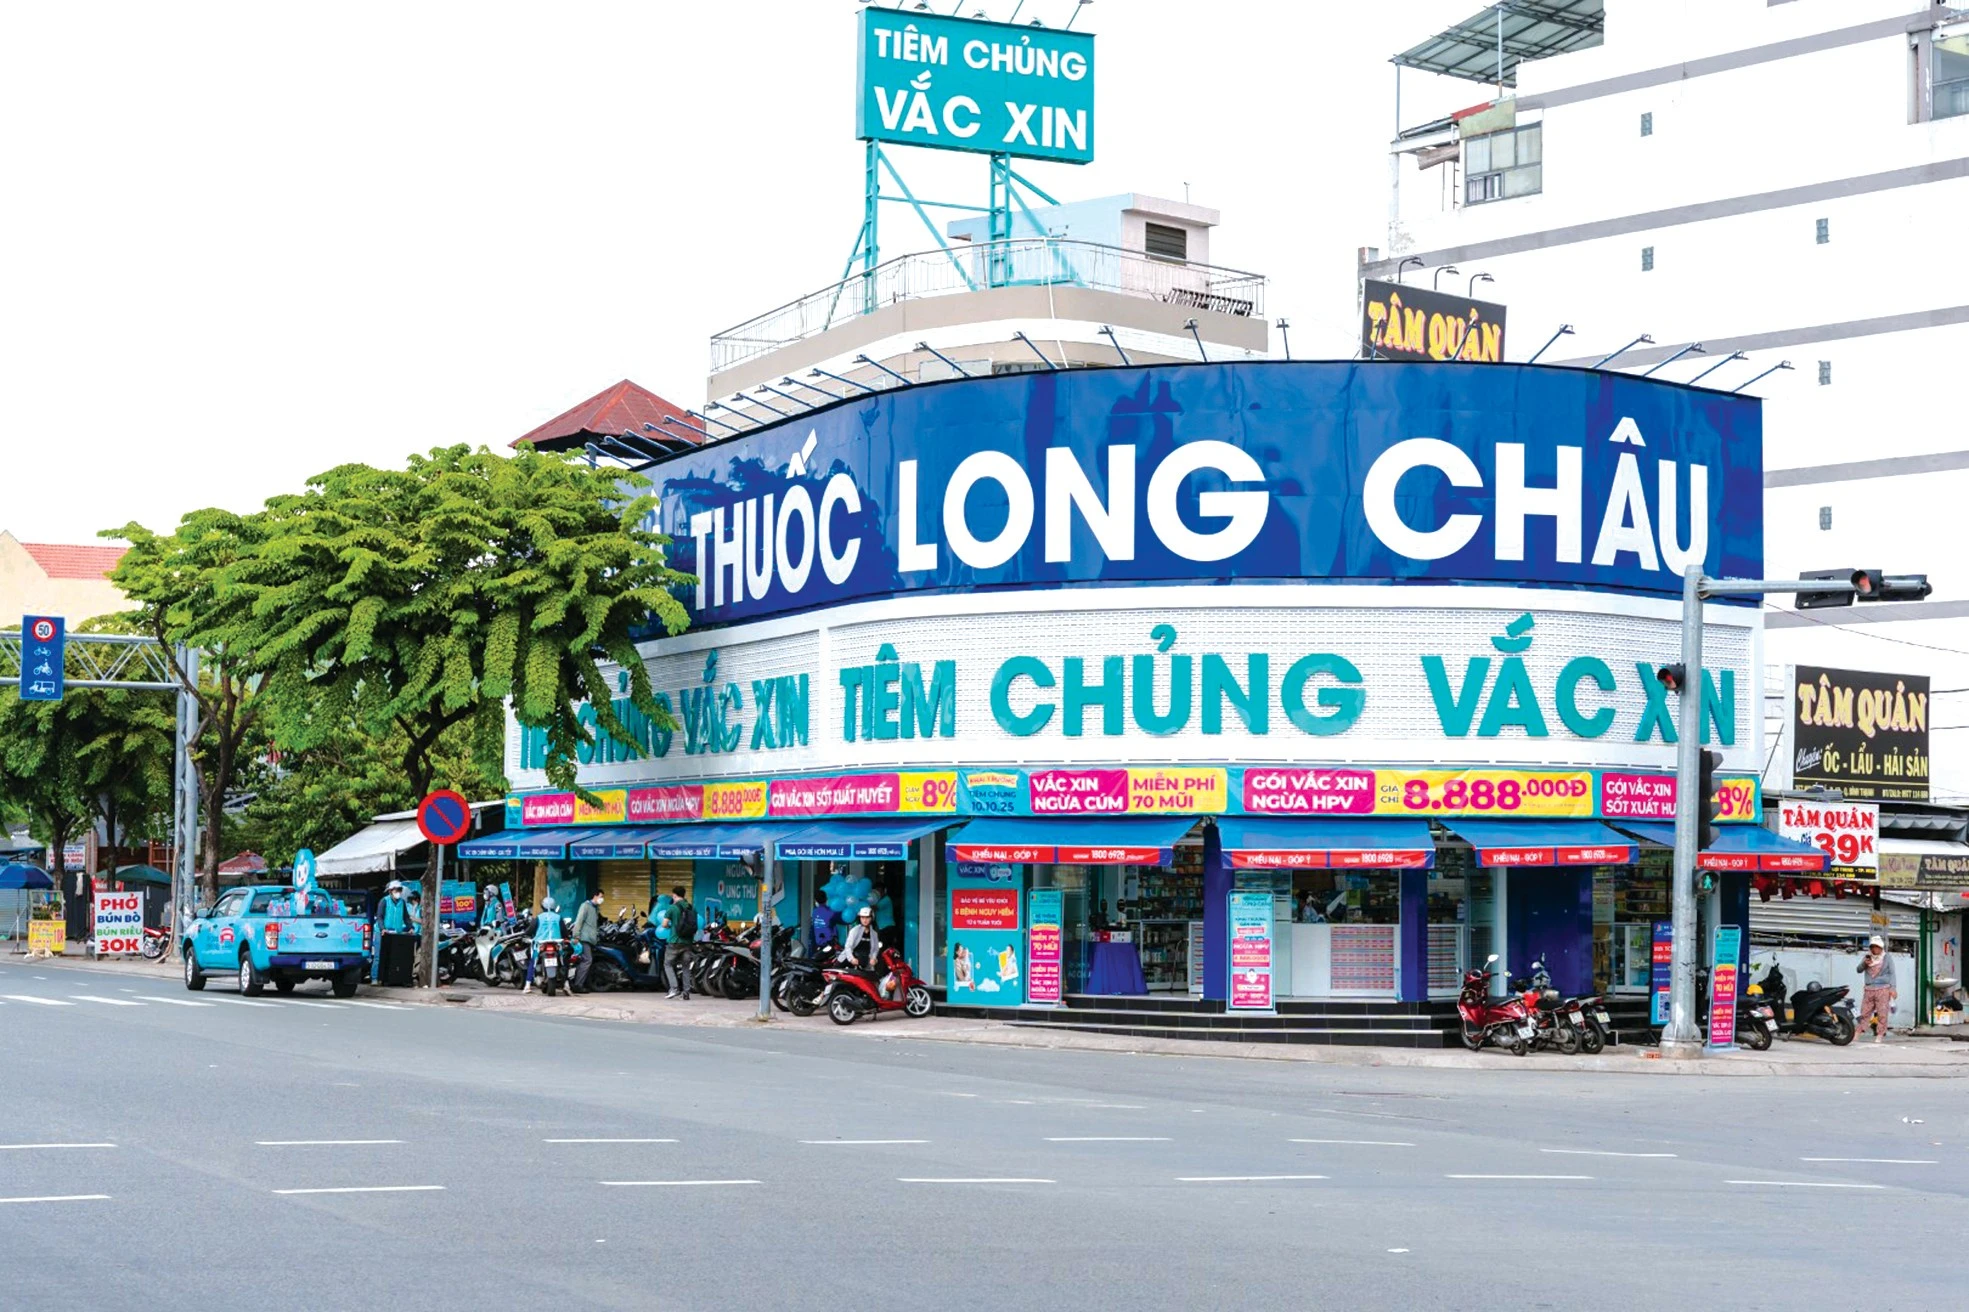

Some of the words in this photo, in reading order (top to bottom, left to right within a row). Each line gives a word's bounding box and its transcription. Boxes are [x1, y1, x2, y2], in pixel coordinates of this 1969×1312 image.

[873, 24, 948, 65] TIÊM
[963, 35, 1088, 81] CHỦNG
[873, 69, 982, 138] VẮC
[1002, 101, 1087, 151] XIN
[1368, 291, 1427, 355] TÂM
[690, 428, 862, 611] THUỐC
[898, 439, 1270, 573] LONG
[1363, 416, 1709, 578] CHÂU
[37, 624, 50, 636] 50
[839, 643, 956, 742] TIÊM
[990, 623, 1366, 737] CHỦNG
[1420, 612, 1617, 738] VẮC
[1634, 661, 1735, 746] XN
[680, 647, 743, 755] VẮC
[751, 673, 809, 751] XIN
[1798, 673, 1854, 728] TÂM
[1823, 742, 1840, 773] ỐC
[1883, 747, 1904, 776] HẢI
[1906, 747, 1928, 777] SẢN
[1032, 773, 1067, 792] VẮC
[1069, 776, 1098, 791] XIN
[1133, 772, 1171, 791] MIỄN
[1185, 774, 1216, 791] PHÍ
[1252, 770, 1286, 790] GÓI
[1291, 770, 1331, 790] VẮC
[1336, 775, 1368, 790] XIN
[1606, 778, 1627, 795] GÓI
[1628, 776, 1652, 796] VẮC
[1653, 784, 1672, 797] XIN
[802, 792, 815, 807] XIN
[816, 784, 832, 806] SỐT
[833, 783, 856, 805] XUẤT
[857, 781, 893, 804] HUYẾT
[922, 779, 957, 808] 8%
[1035, 793, 1078, 810] NGỪA
[1084, 792, 1124, 810] CÚM
[1135, 795, 1155, 808] 70
[1159, 791, 1193, 808] MŨI
[1252, 792, 1308, 810] NGỪA
[1314, 795, 1354, 810] HPV
[1403, 778, 1587, 810] 8.888.000Đ
[1718, 786, 1753, 816] 8%
[971, 801, 1015, 812] 10.10.25
[1606, 795, 1628, 813] SỐT
[1630, 797, 1659, 815] XUẤT
[1783, 804, 1822, 828] TÂM
[1014, 848, 1031, 859] GÓP
[1815, 833, 1874, 864] 39K
[100, 893, 138, 910] PHỞ
[97, 911, 122, 923] BÚN
[125, 911, 141, 923] BÒ
[97, 926, 118, 936] BÚN
